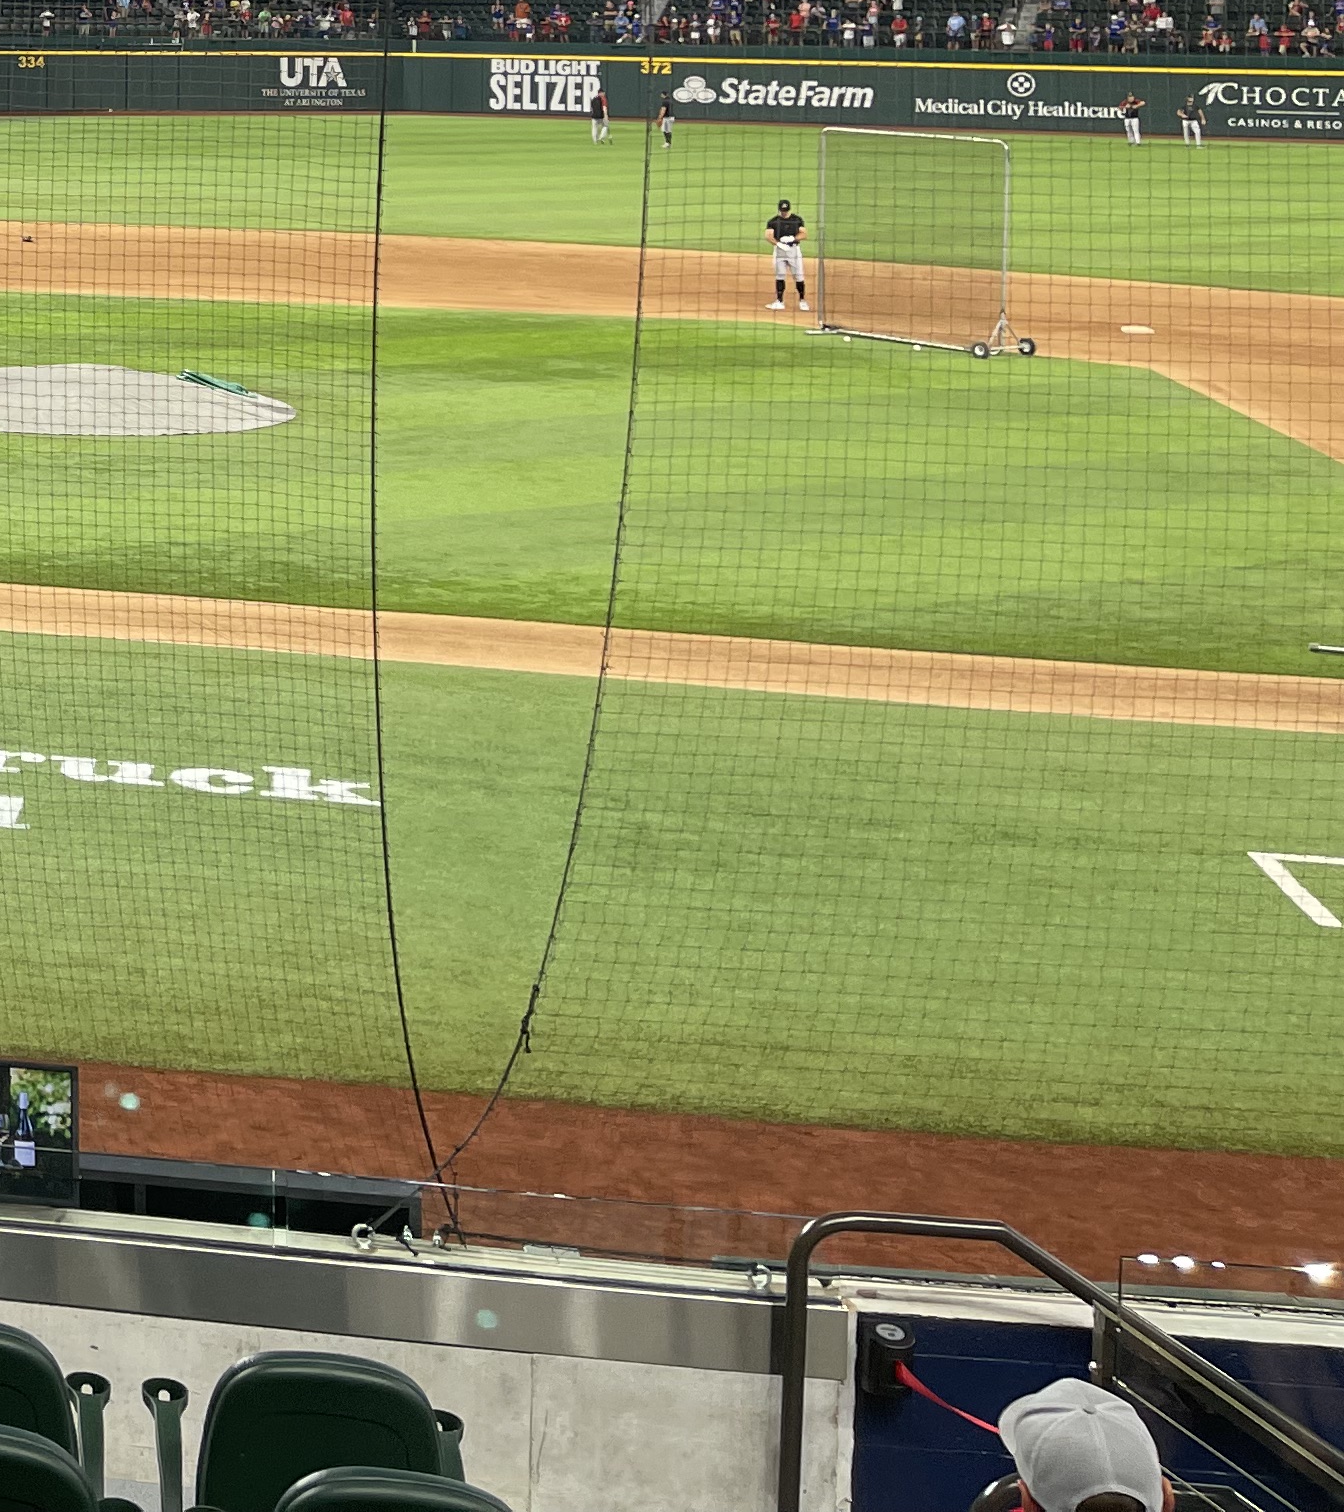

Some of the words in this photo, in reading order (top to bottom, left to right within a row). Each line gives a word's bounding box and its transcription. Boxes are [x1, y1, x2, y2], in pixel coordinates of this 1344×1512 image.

[18, 55, 45, 68] 334
[490, 59, 536, 74] BUD
[538, 60, 601, 76] LIGHT
[641, 60, 672, 75] 372
[280, 57, 348, 87] UTA
[340, 89, 366, 97] TEXAS
[489, 74, 601, 113] SELTZER
[295, 99, 343, 107] ARLINGTON
[915, 98, 986, 116] Medical
[987, 99, 1023, 120] City
[1028, 100, 1126, 119] Healthcare
[1228, 117, 1289, 128] CASINOS
[1294, 119, 1303, 128] &
[1306, 120, 1343, 131] RESO
